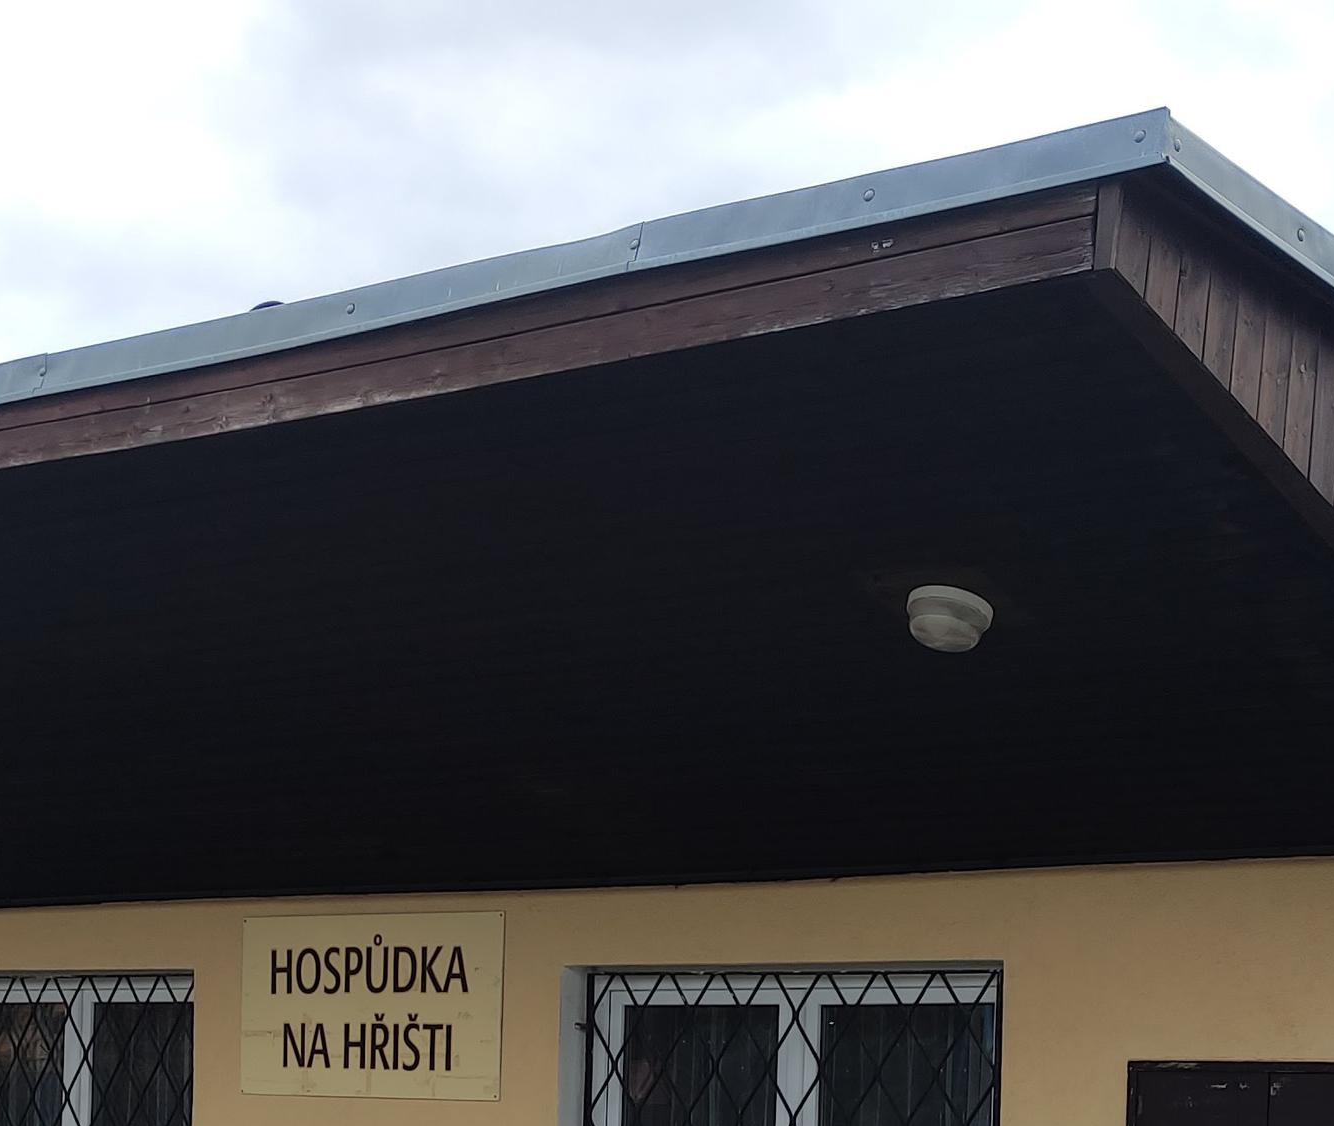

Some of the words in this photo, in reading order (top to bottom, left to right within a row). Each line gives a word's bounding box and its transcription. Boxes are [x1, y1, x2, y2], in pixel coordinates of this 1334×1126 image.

[270, 934, 469, 995] HOSPŮDKA
[282, 1022, 331, 1068] NA
[343, 1013, 453, 1072] HŘIŠTI
